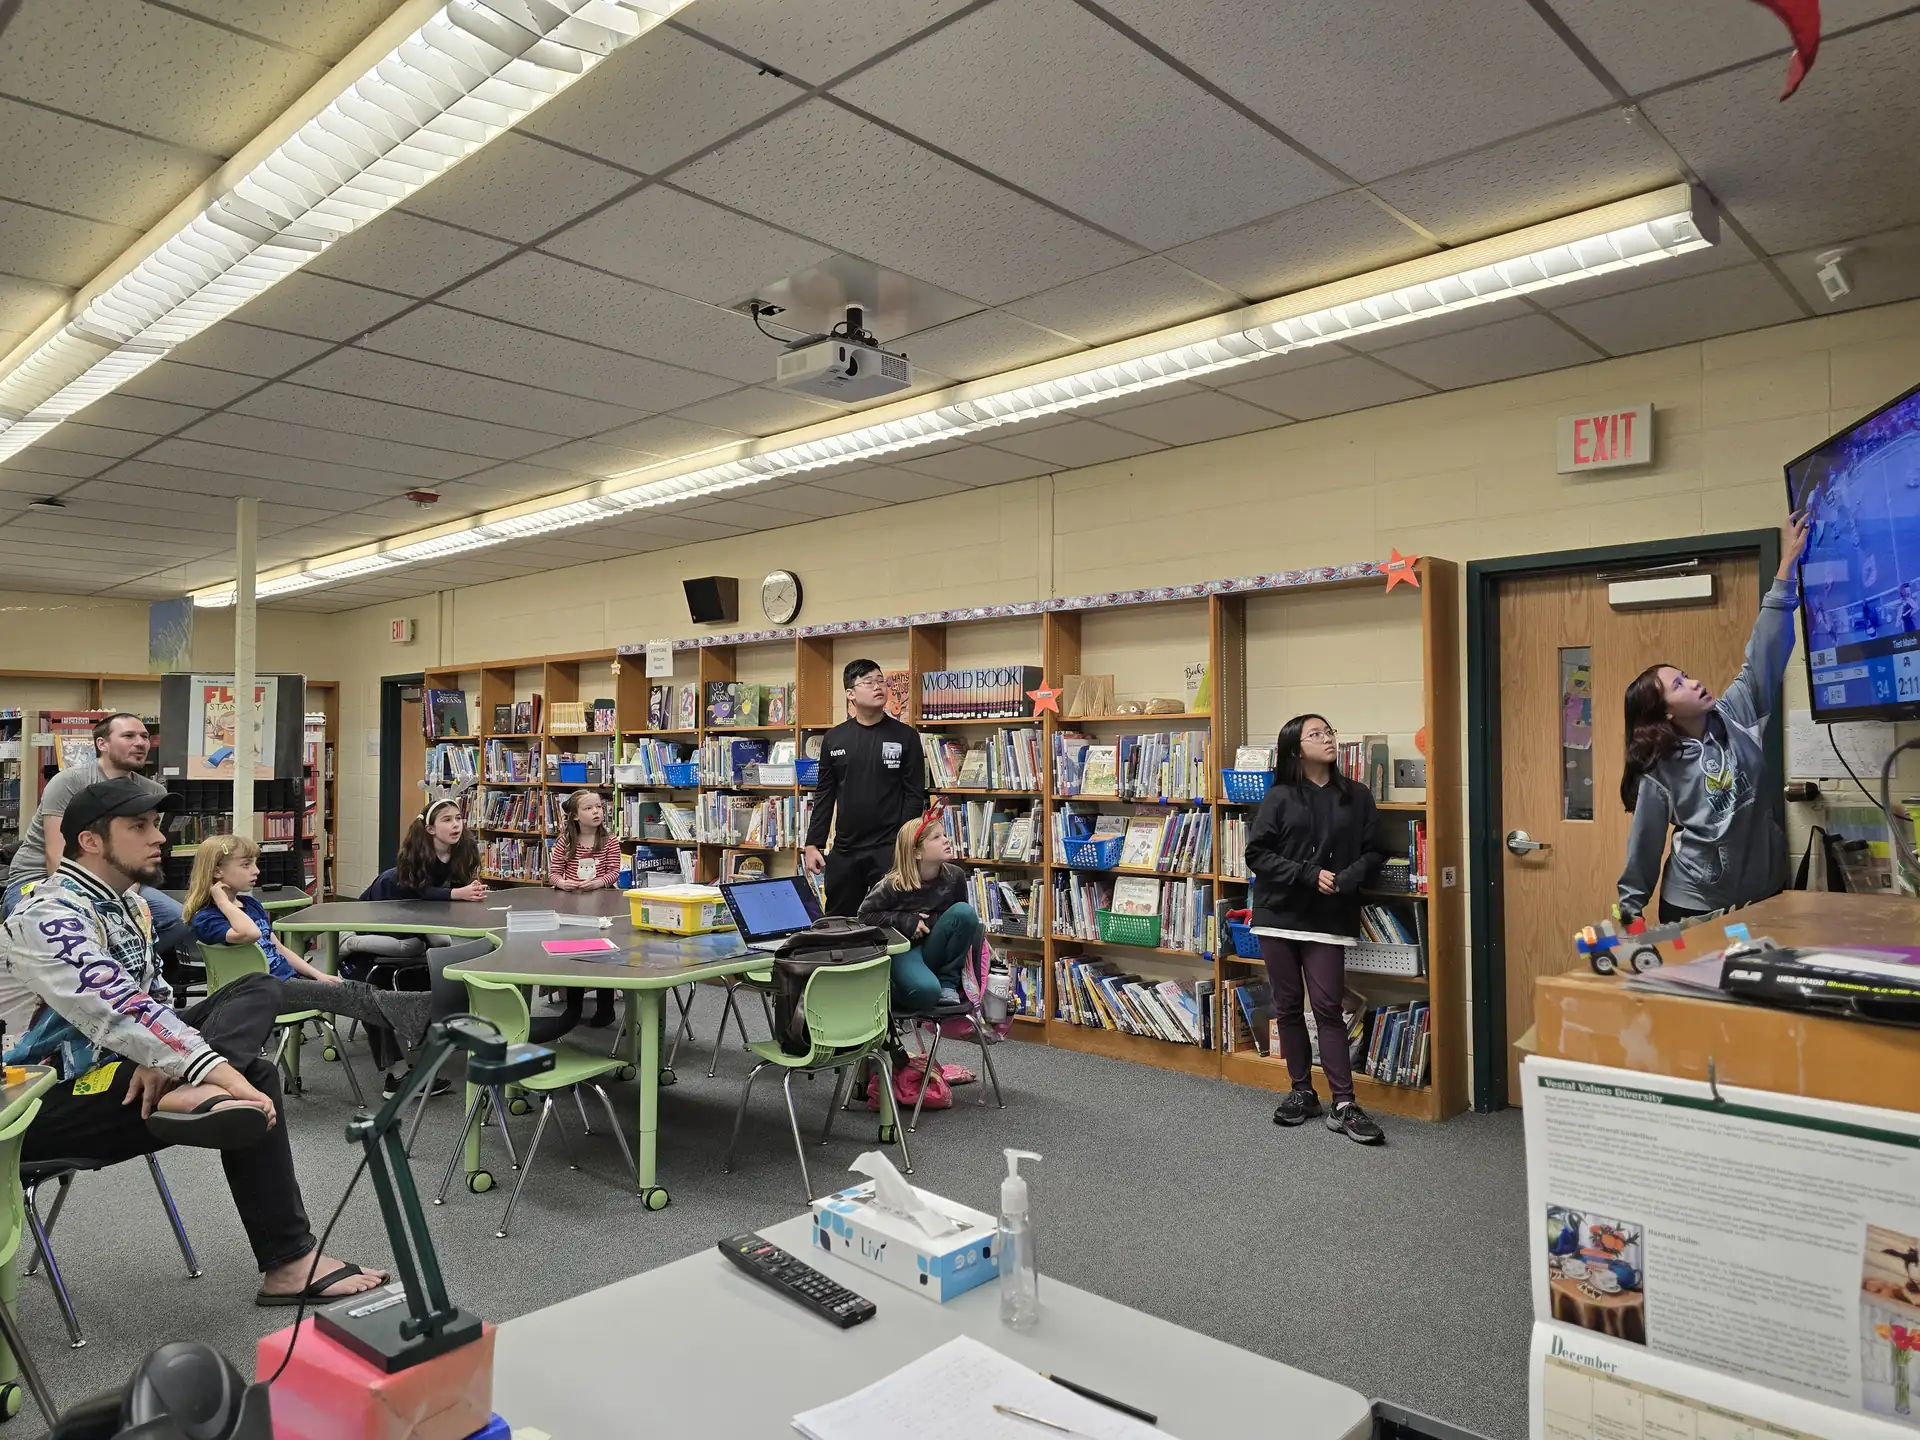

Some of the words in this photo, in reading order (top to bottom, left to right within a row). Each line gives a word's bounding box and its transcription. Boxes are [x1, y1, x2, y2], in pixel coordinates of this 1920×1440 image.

[1574, 412, 1637, 464] EXIT
[922, 673, 973, 691] WORLD
[976, 668, 1019, 688] BOOK
[1877, 680, 1890, 698] 34
[204, 686, 265, 703] FLT
[637, 858, 662, 870] GREATEST
[39, 917, 180, 1029] BASQUIAT
[1826, 980, 1869, 993] Bluetooth
[1544, 1078, 1576, 1091] Vestal
[1578, 1083, 1613, 1095] Values
[1615, 1087, 1664, 1104] Diversity
[1550, 1334, 1618, 1373] December
